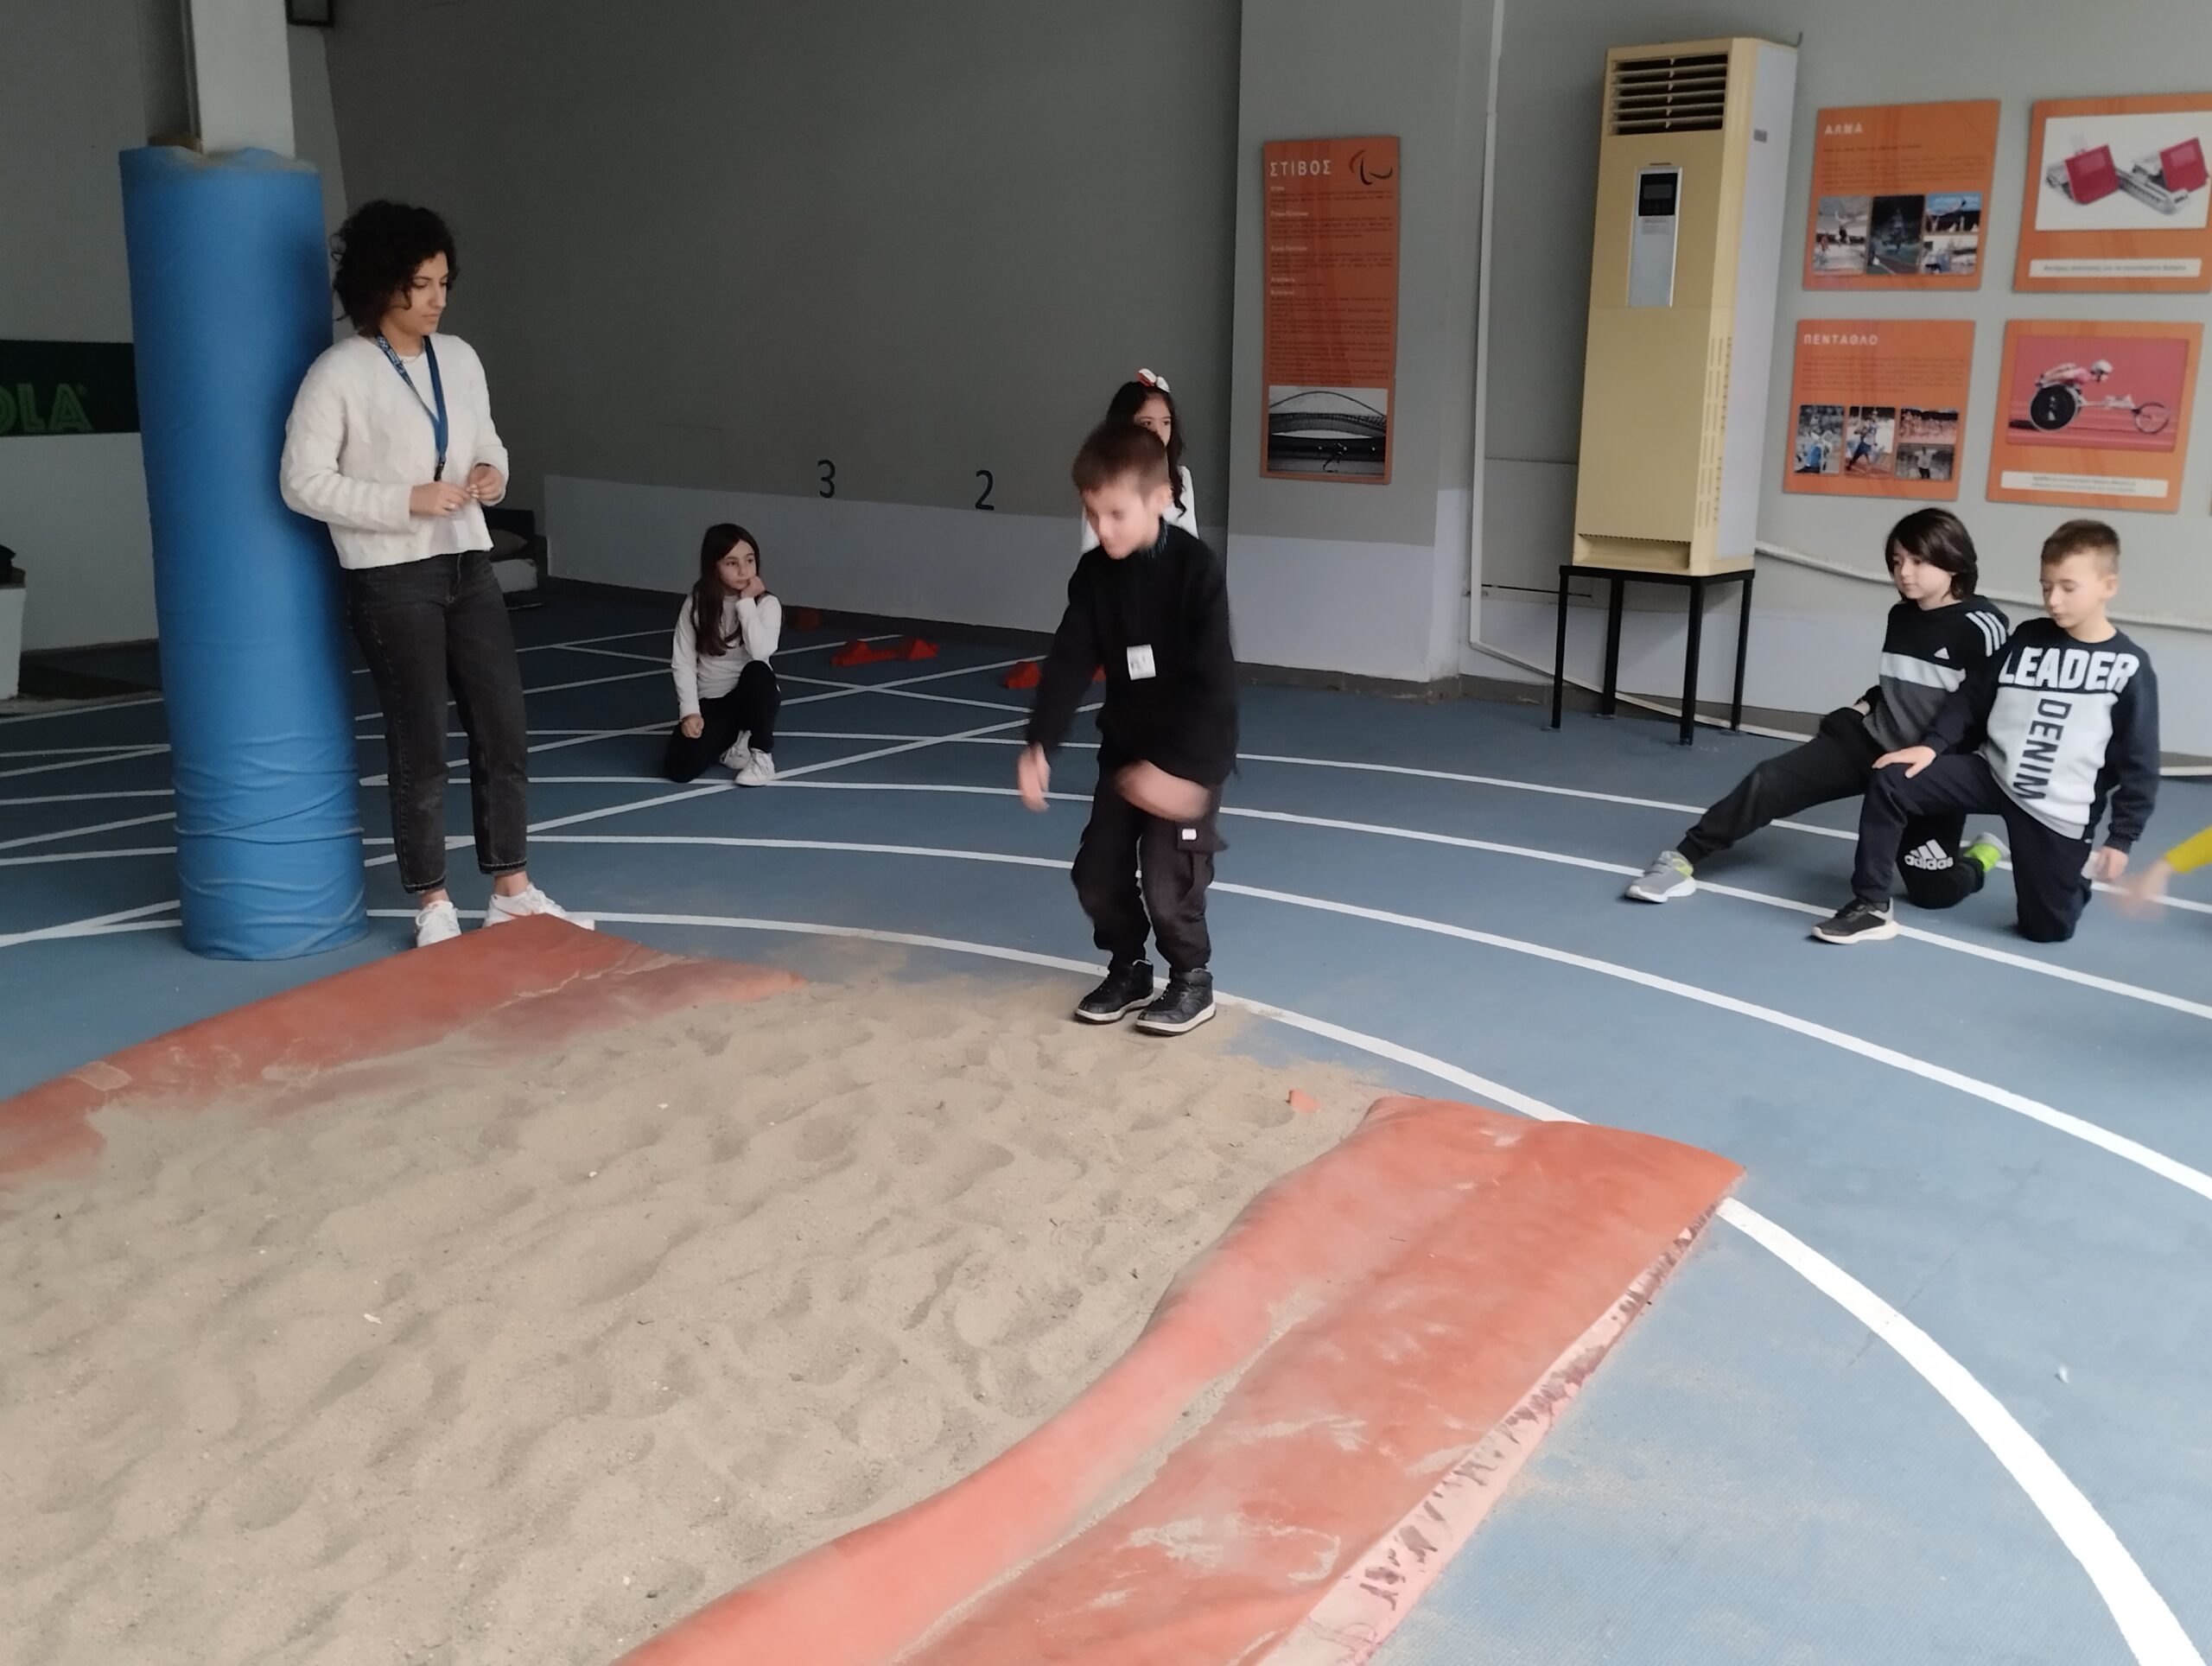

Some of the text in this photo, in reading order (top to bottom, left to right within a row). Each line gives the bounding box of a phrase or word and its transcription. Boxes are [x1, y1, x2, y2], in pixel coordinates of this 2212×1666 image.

[1269, 160, 1332, 177] ΣΤΙΒΟΣ
[1803, 334, 1878, 346] ΠΕΝΤΑΘΛΟ
[817, 459, 836, 499] 3
[975, 469, 995, 511] 2
[1998, 646, 2140, 693] LEADER
[2012, 697, 2073, 800] DENIM
[1904, 854, 1955, 870] adidas
